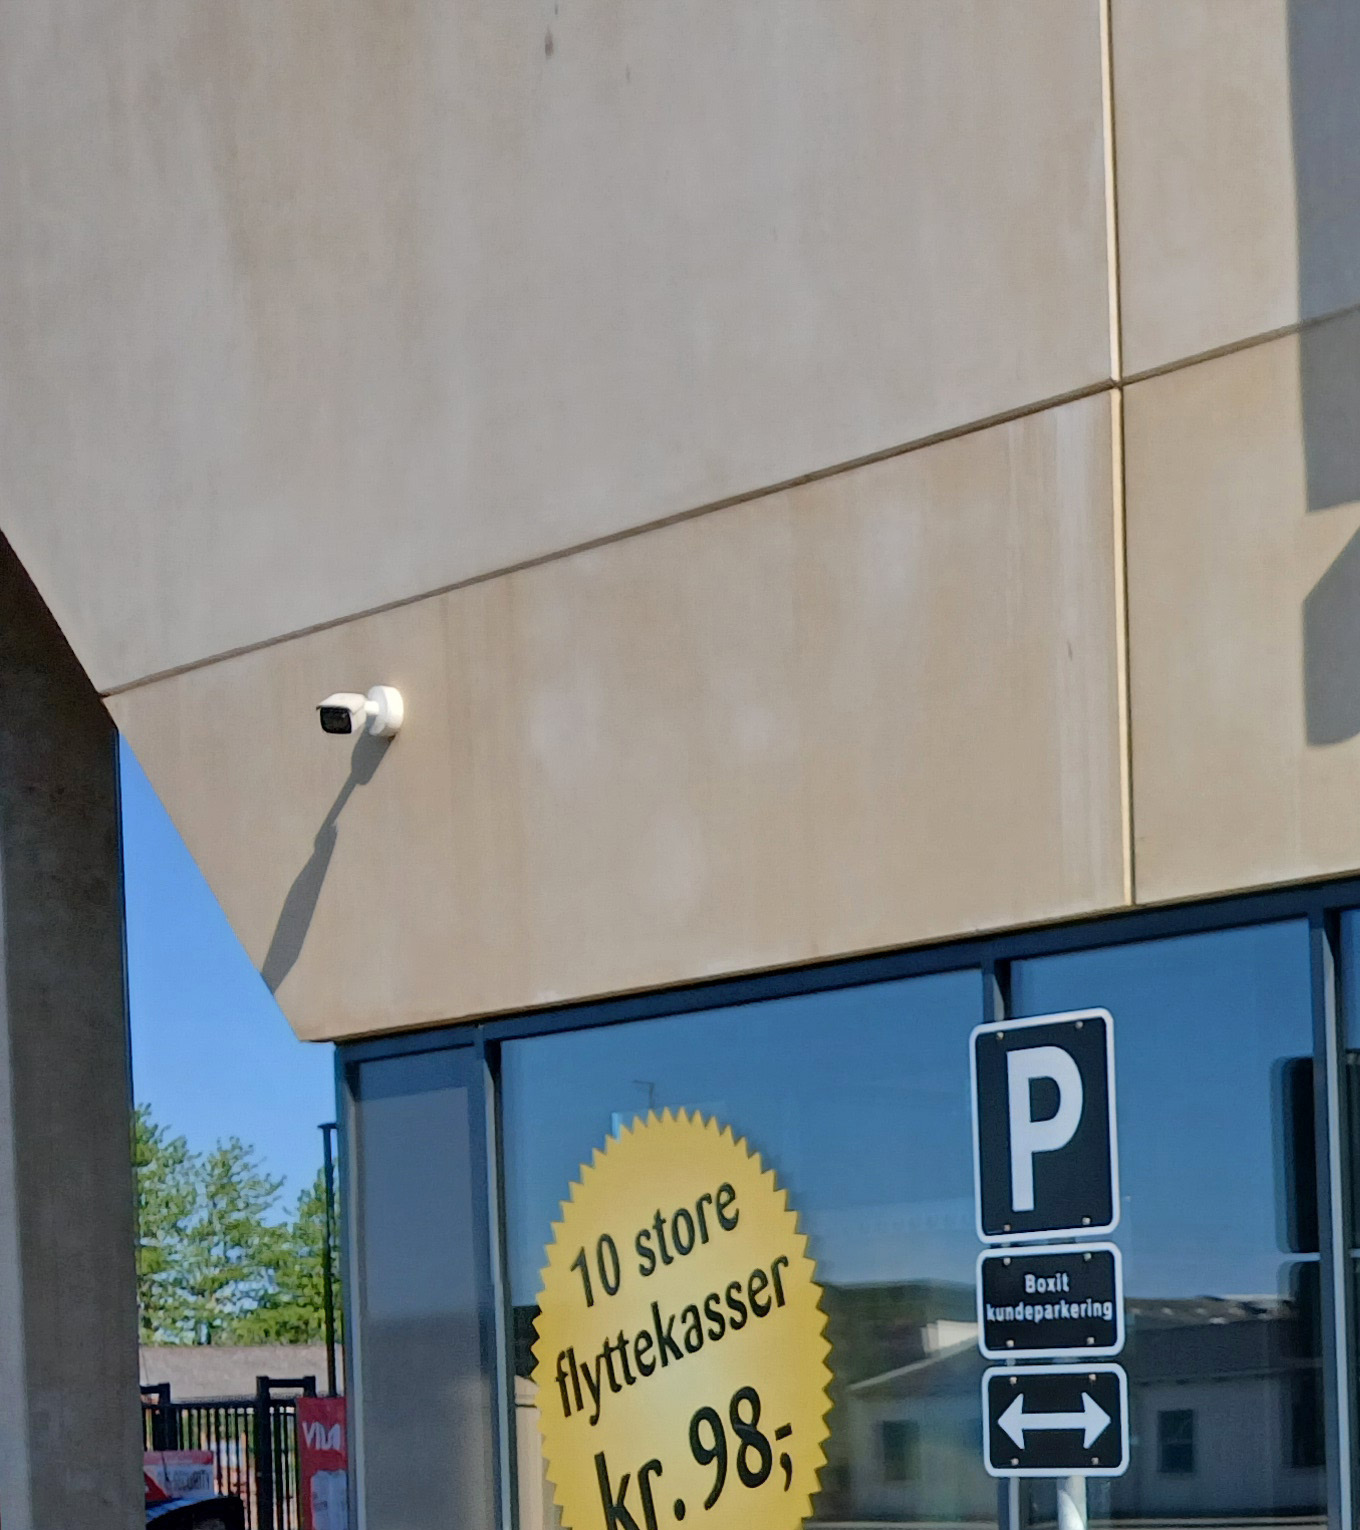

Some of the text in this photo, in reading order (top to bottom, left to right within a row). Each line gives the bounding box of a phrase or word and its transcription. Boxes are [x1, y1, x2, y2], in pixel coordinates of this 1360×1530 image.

[1006, 1045, 1084, 1213] P
[570, 1181, 741, 1308] 10 store
[1024, 1273, 1070, 1294] Boxit
[554, 1254, 791, 1427] flyttekasser
[986, 1298, 1113, 1324] kundeparkering
